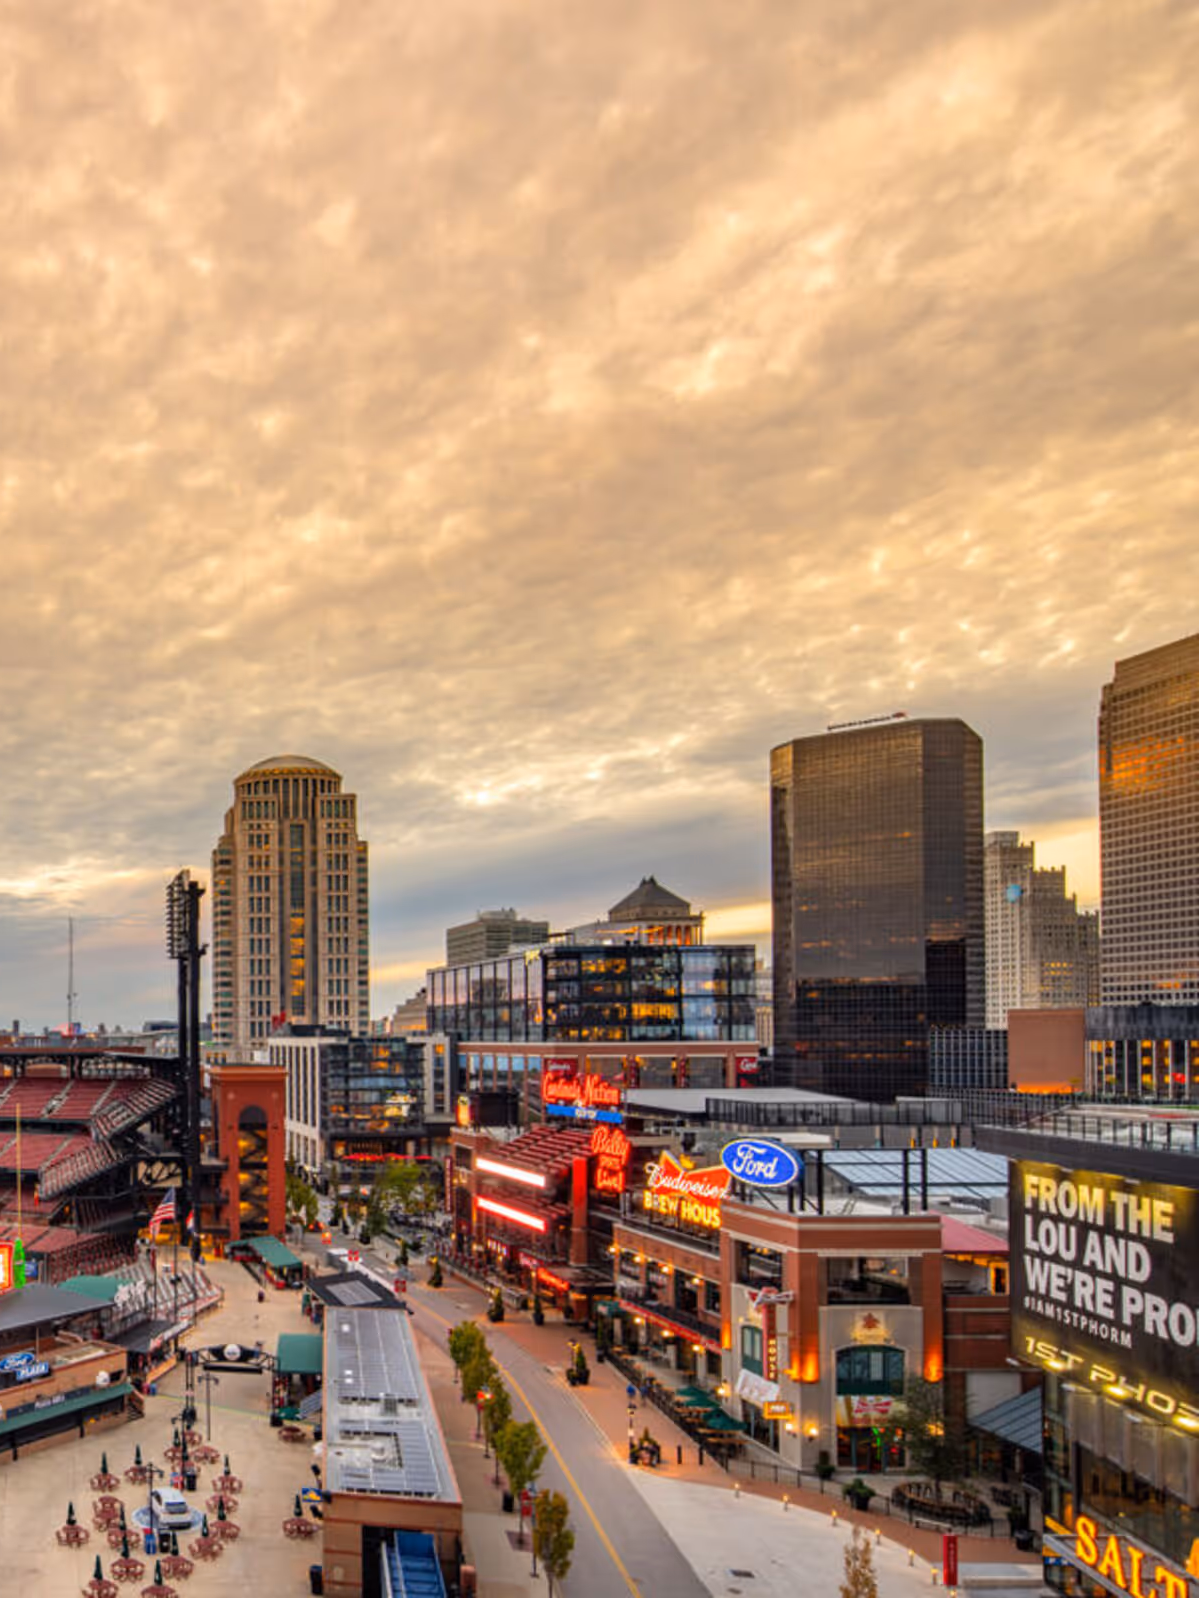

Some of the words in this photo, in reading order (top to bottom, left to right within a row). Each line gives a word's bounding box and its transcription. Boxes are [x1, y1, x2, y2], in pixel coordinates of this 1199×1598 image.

[582, 1073, 620, 1108] Nation
[644, 1162, 730, 1199] Budweiser
[732, 1143, 779, 1179] Ford
[643, 1189, 679, 1217] BREW
[681, 1200, 721, 1230] HOUS
[1024, 1173, 1105, 1227] FROM
[1110, 1190, 1175, 1244] THE
[1024, 1213, 1078, 1262] LOU
[1082, 1229, 1152, 1283] AND
[1023, 1254, 1116, 1320] WE'RE
[1121, 1284, 1199, 1347] PRO
[1023, 1296, 1134, 1349] #IAM1STPHORM
[1025, 1335, 1085, 1371] 1ST
[1075, 1513, 1188, 1598] SALT
